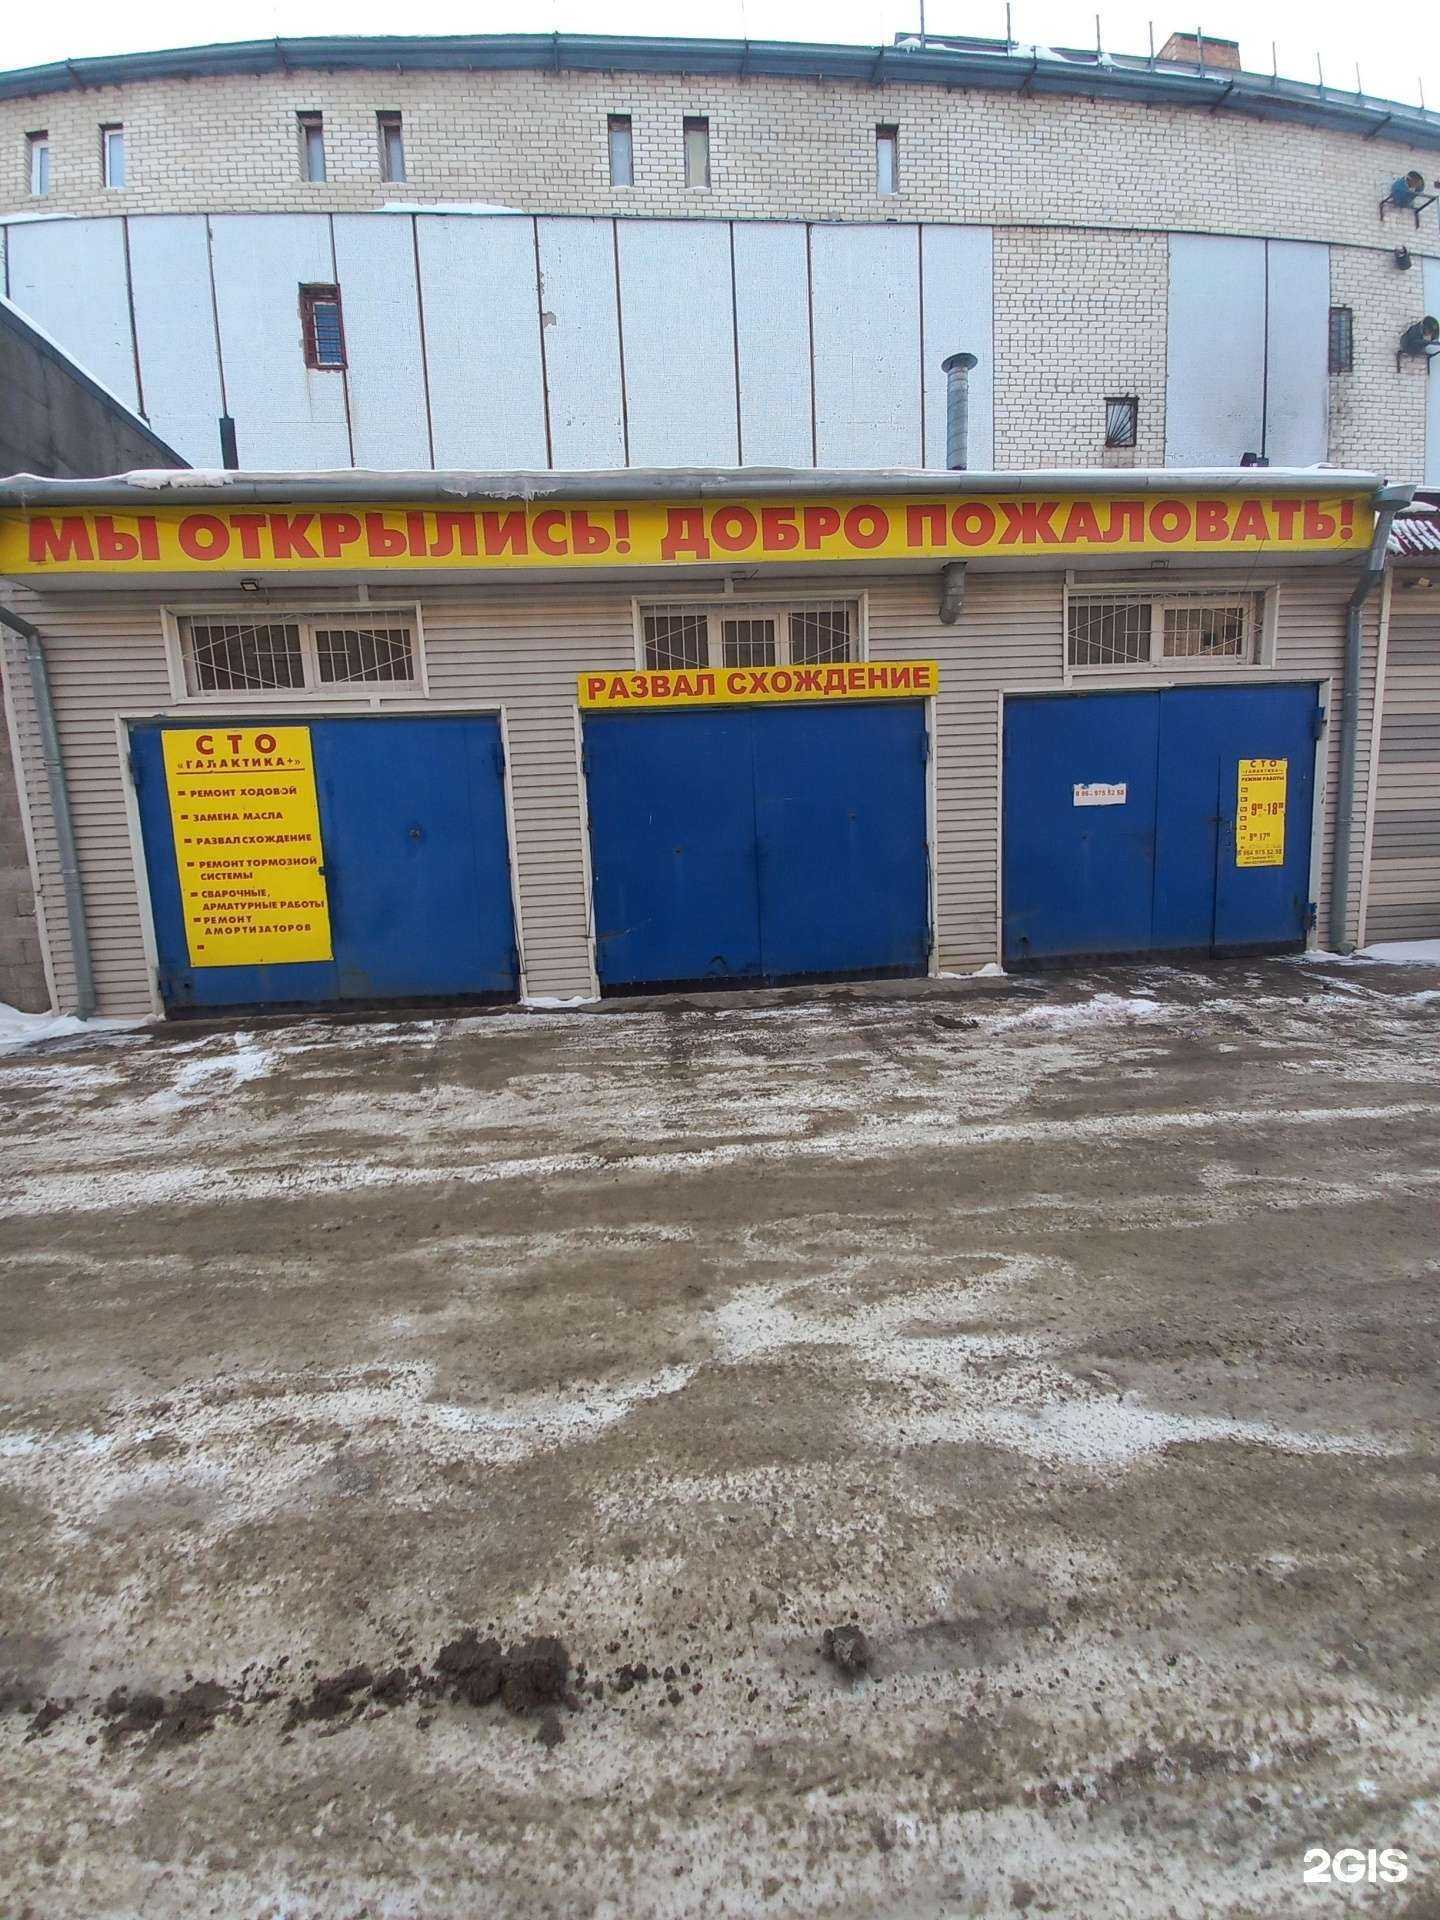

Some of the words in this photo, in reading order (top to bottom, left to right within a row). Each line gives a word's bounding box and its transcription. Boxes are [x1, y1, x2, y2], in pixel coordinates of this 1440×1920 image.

[28, 514, 160, 563] МЫ
[177, 507, 631, 561] ОТКРЫЛИСЬ!
[661, 503, 889, 560] ДОБРО
[907, 500, 1354, 548] ПОЖАЛОВАТЬ!
[588, 673, 716, 700] РАЗВАЛ
[726, 666, 932, 696] СХОЖДЕНИЕ
[196, 733, 277, 755] СТО
[190, 788, 236, 798] РЕМОНТ
[240, 786, 297, 796] ХОДОВОЙ
[193, 812, 239, 822] ЗАМЕНА
[243, 812, 283, 821] МАСЛА
[199, 860, 245, 869] РЕМОНТ
[246, 856, 317, 867] ТОРМОЗНОЙ
[200, 871, 253, 881] СИСТЕМЫ
[201, 889, 271, 899] СВАРОЧНЫЕ,
[202, 901, 278, 911] АРМАТУРНЫЕ
[279, 900, 324, 909] РАБОТЫ
[204, 915, 253, 924] РЕМОНТ
[204, 924, 312, 935] АМОРТИЗАТОРОВ
